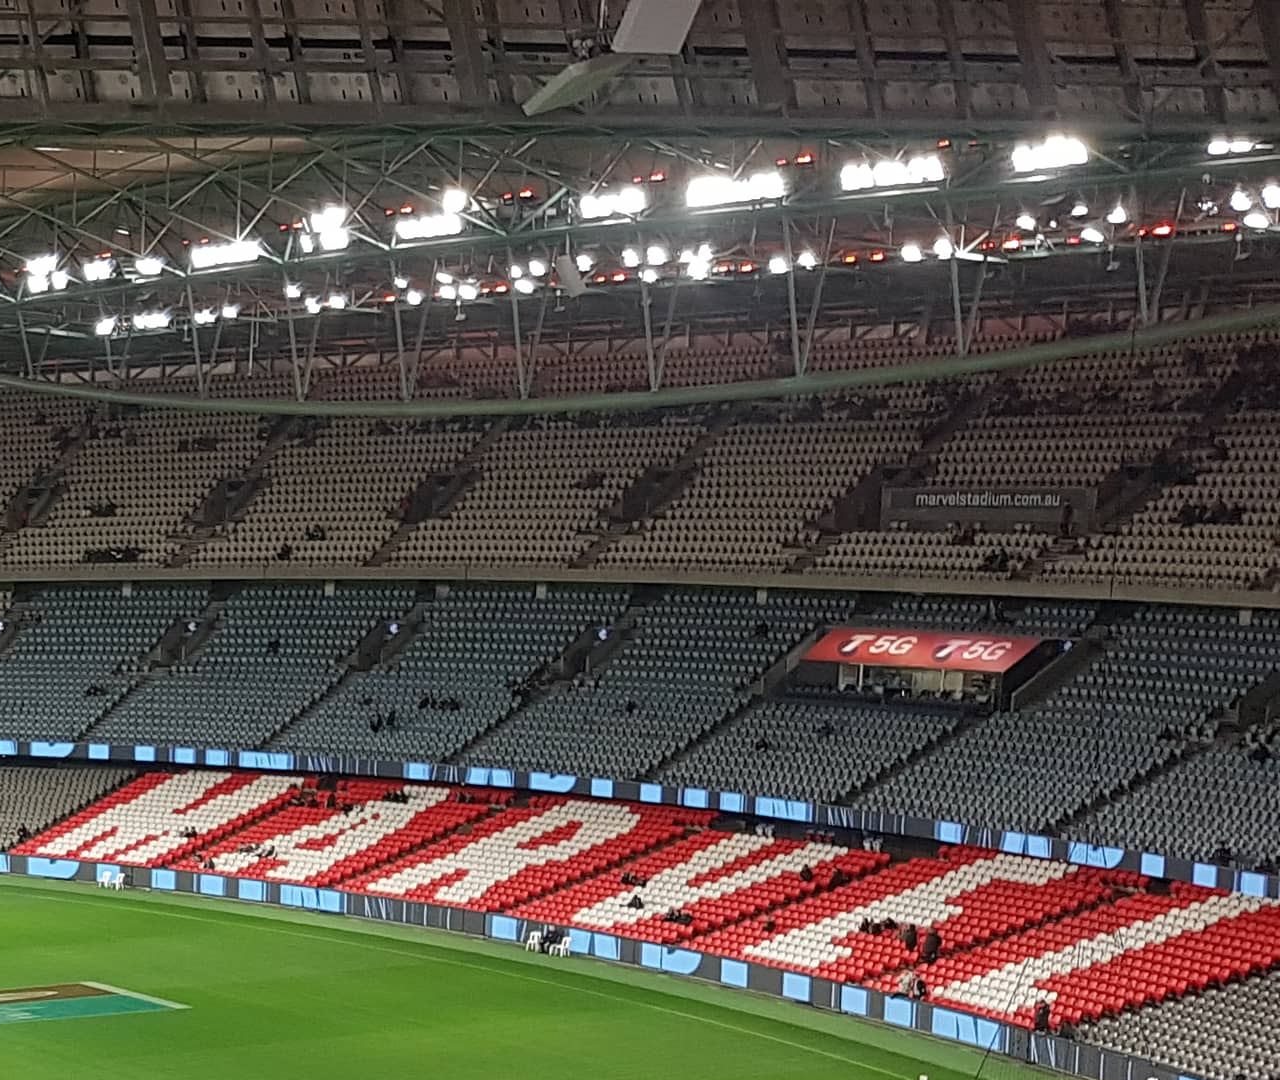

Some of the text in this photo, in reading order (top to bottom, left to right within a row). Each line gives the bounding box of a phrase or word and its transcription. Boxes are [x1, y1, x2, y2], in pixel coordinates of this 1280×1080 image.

[915, 491, 1060, 507] marvelstadium.com.au
[869, 636, 918, 655] 5G
[962, 641, 1012, 660] 5G
